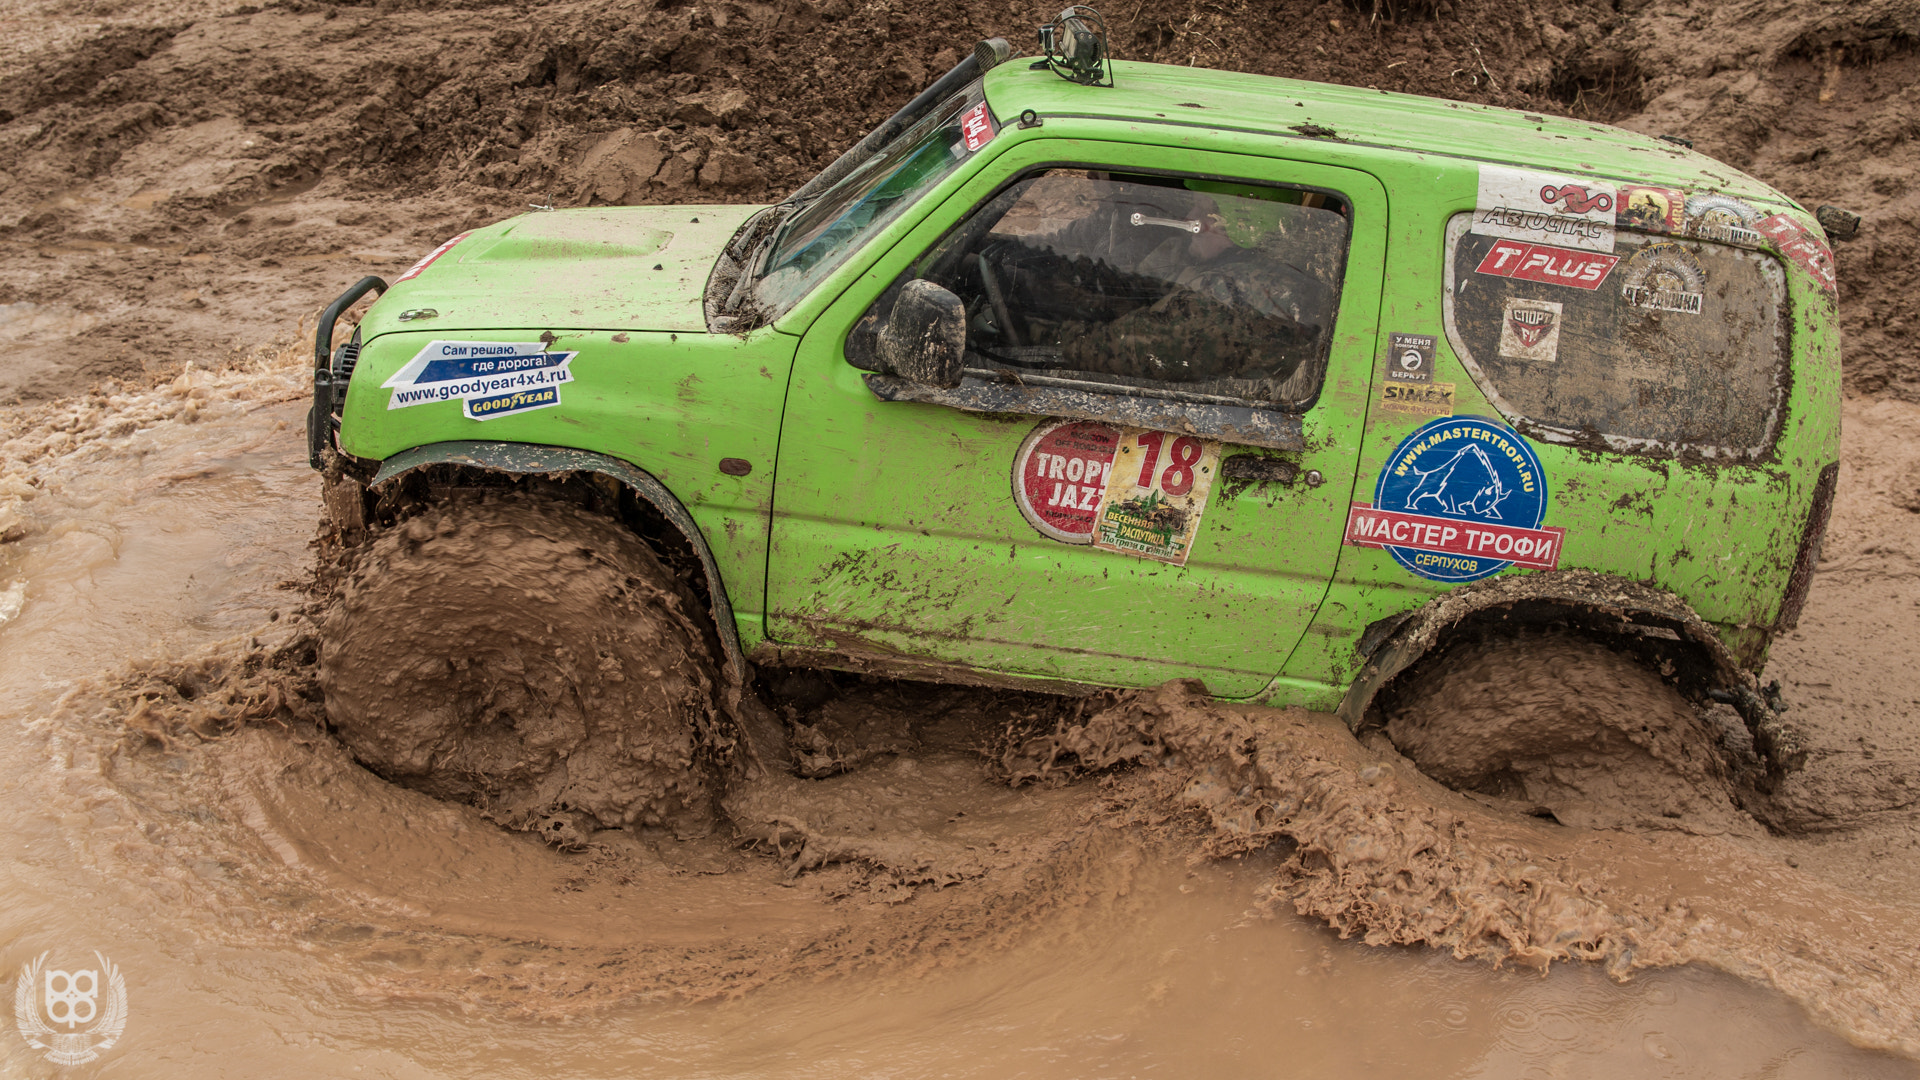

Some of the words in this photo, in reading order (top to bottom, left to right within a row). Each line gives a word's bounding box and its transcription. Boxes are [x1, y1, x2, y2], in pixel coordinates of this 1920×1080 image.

[1482, 206, 1607, 239] АВТОСПАС
[1494, 246, 1523, 269] T
[1522, 253, 1607, 281] PLUS
[1513, 309, 1554, 325] СПОРТ
[442, 345, 468, 356] Сам
[471, 346, 517, 357] решаю,
[1404, 337, 1431, 346] МЕНЯ
[472, 361, 495, 372] где
[498, 355, 547, 371] дорога!
[1391, 370, 1427, 380] БЕРКУТ
[396, 369, 567, 403] www.goodyear4x4.ru
[472, 390, 554, 413] GOODYEAR
[1136, 430, 1204, 498] 18
[1394, 427, 1534, 493] WWW.MASTERTROFI.RU
[1107, 511, 1154, 529] ВЕСЕННЯЯ
[1120, 526, 1165, 545] РАСПУТИЦА
[1354, 515, 1457, 547] МАСТЕР
[1465, 529, 1554, 560] ТРОФИ
[1415, 553, 1478, 572] СЕРПУХОВ
